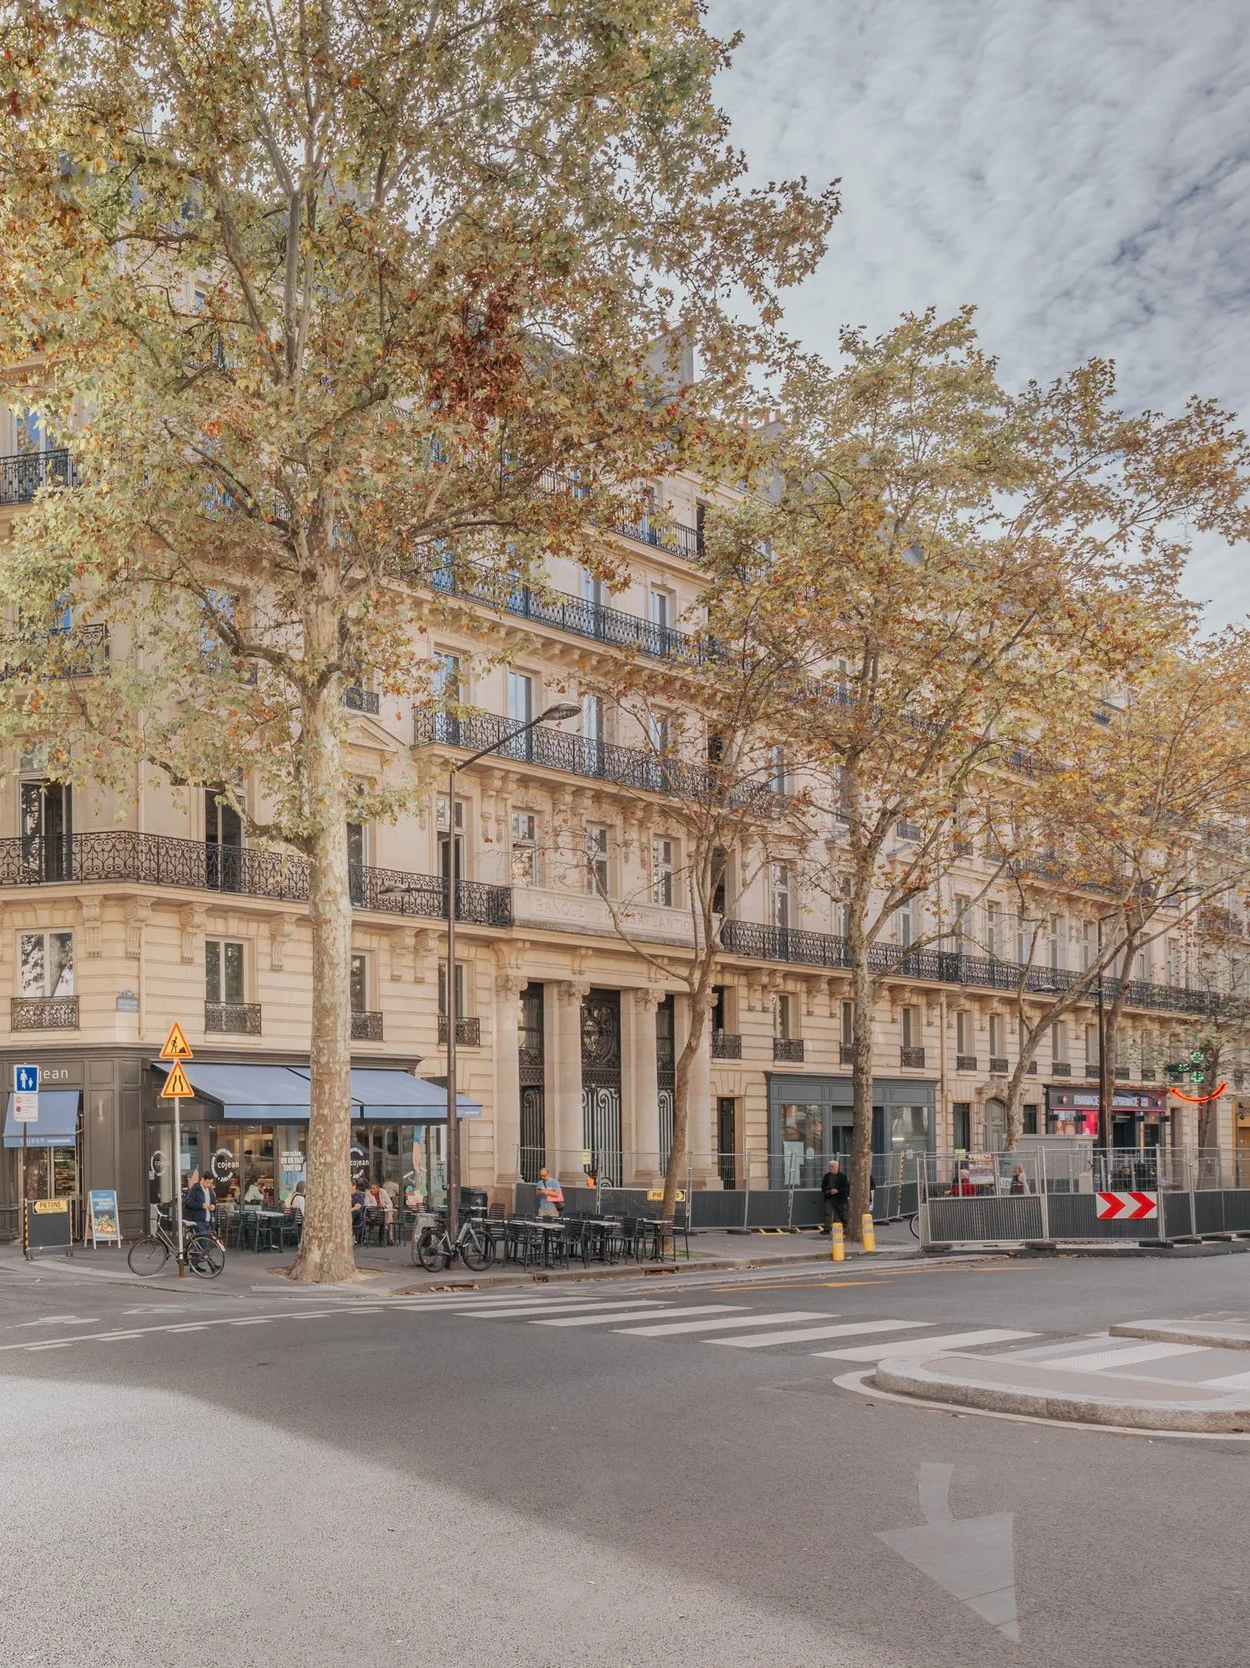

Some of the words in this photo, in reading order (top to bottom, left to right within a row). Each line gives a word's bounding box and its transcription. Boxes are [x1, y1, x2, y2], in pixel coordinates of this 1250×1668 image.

[535, 898, 585, 918] BANQUE
[38, 1066, 69, 1083] jean
[217, 1160, 240, 1170] cojean
